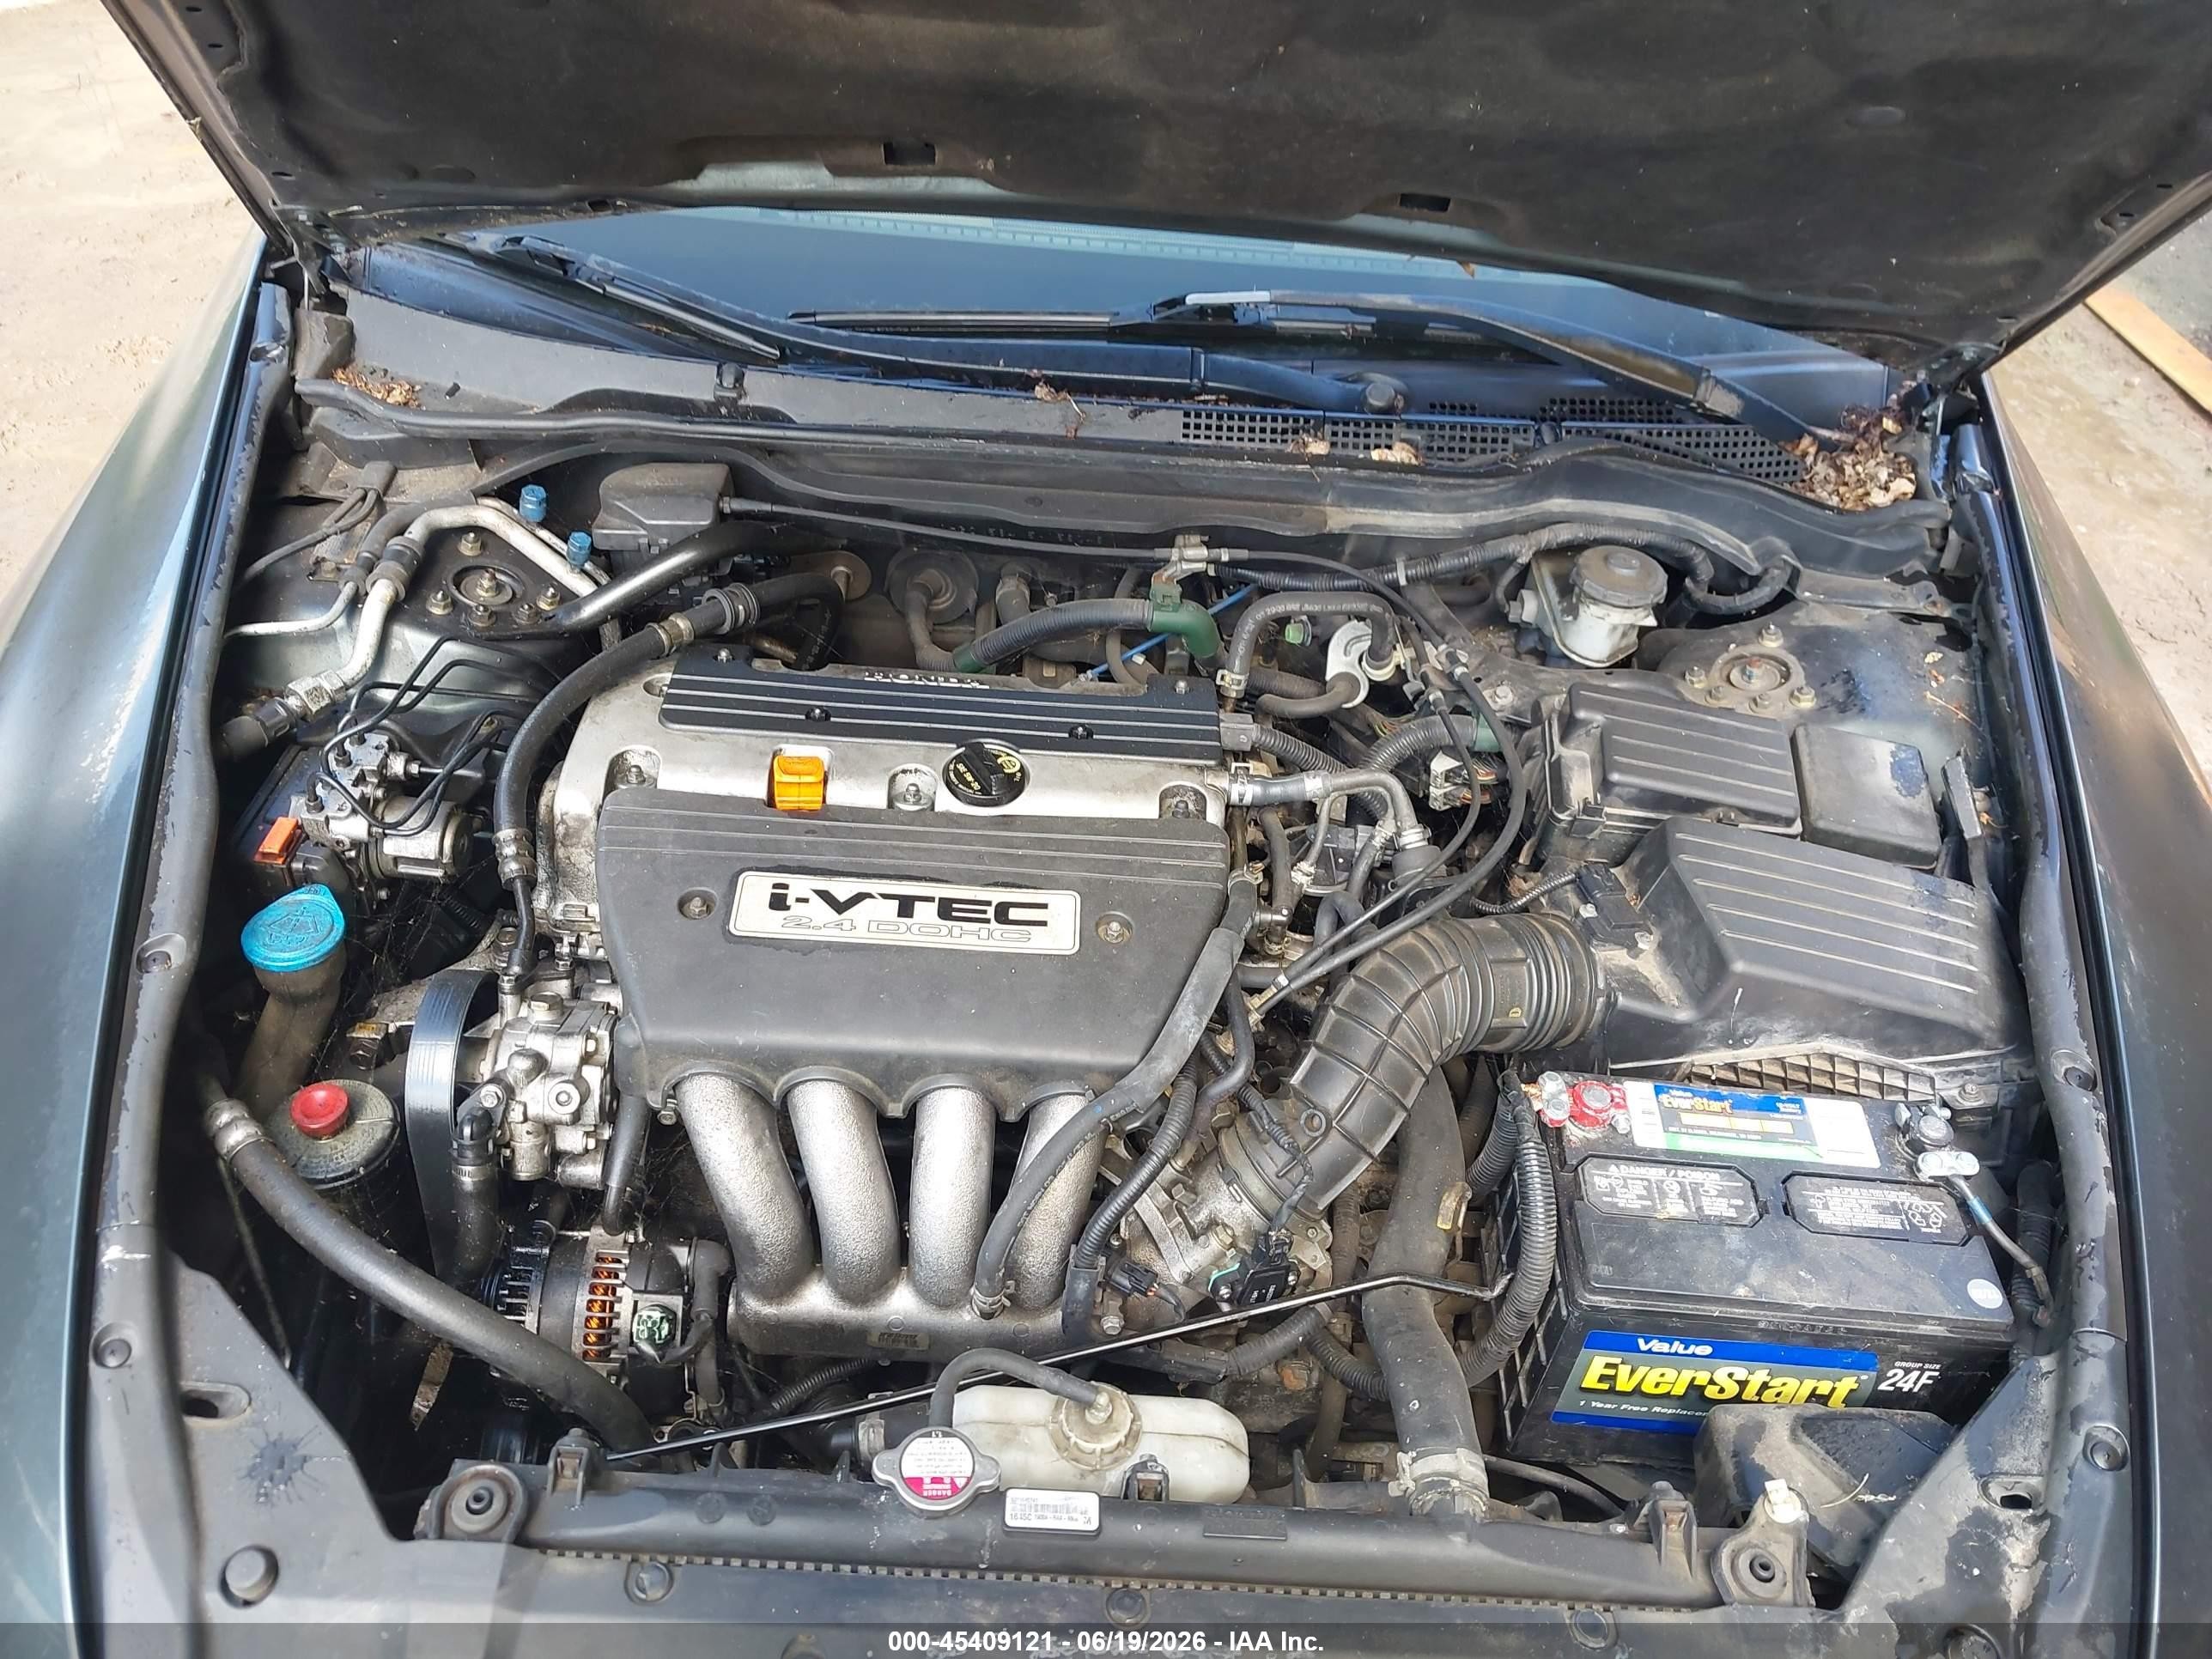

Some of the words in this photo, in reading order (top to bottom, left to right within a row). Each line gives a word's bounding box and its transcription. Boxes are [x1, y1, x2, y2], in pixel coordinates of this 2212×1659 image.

[769, 883, 1048, 927] i-VTEC
[781, 915, 857, 932] 2.4
[867, 920, 1032, 943] DOHC
[1658, 1094, 1733, 1115] EverStart
[1620, 1165, 1667, 1177] DANGER
[1637, 1337, 1713, 1356] Value
[1580, 1354, 1859, 1409] EverStart
[1877, 1368, 1941, 1393] 24F
[1590, 1401, 1619, 1409] Year
[1620, 1404, 1649, 1413] Free
